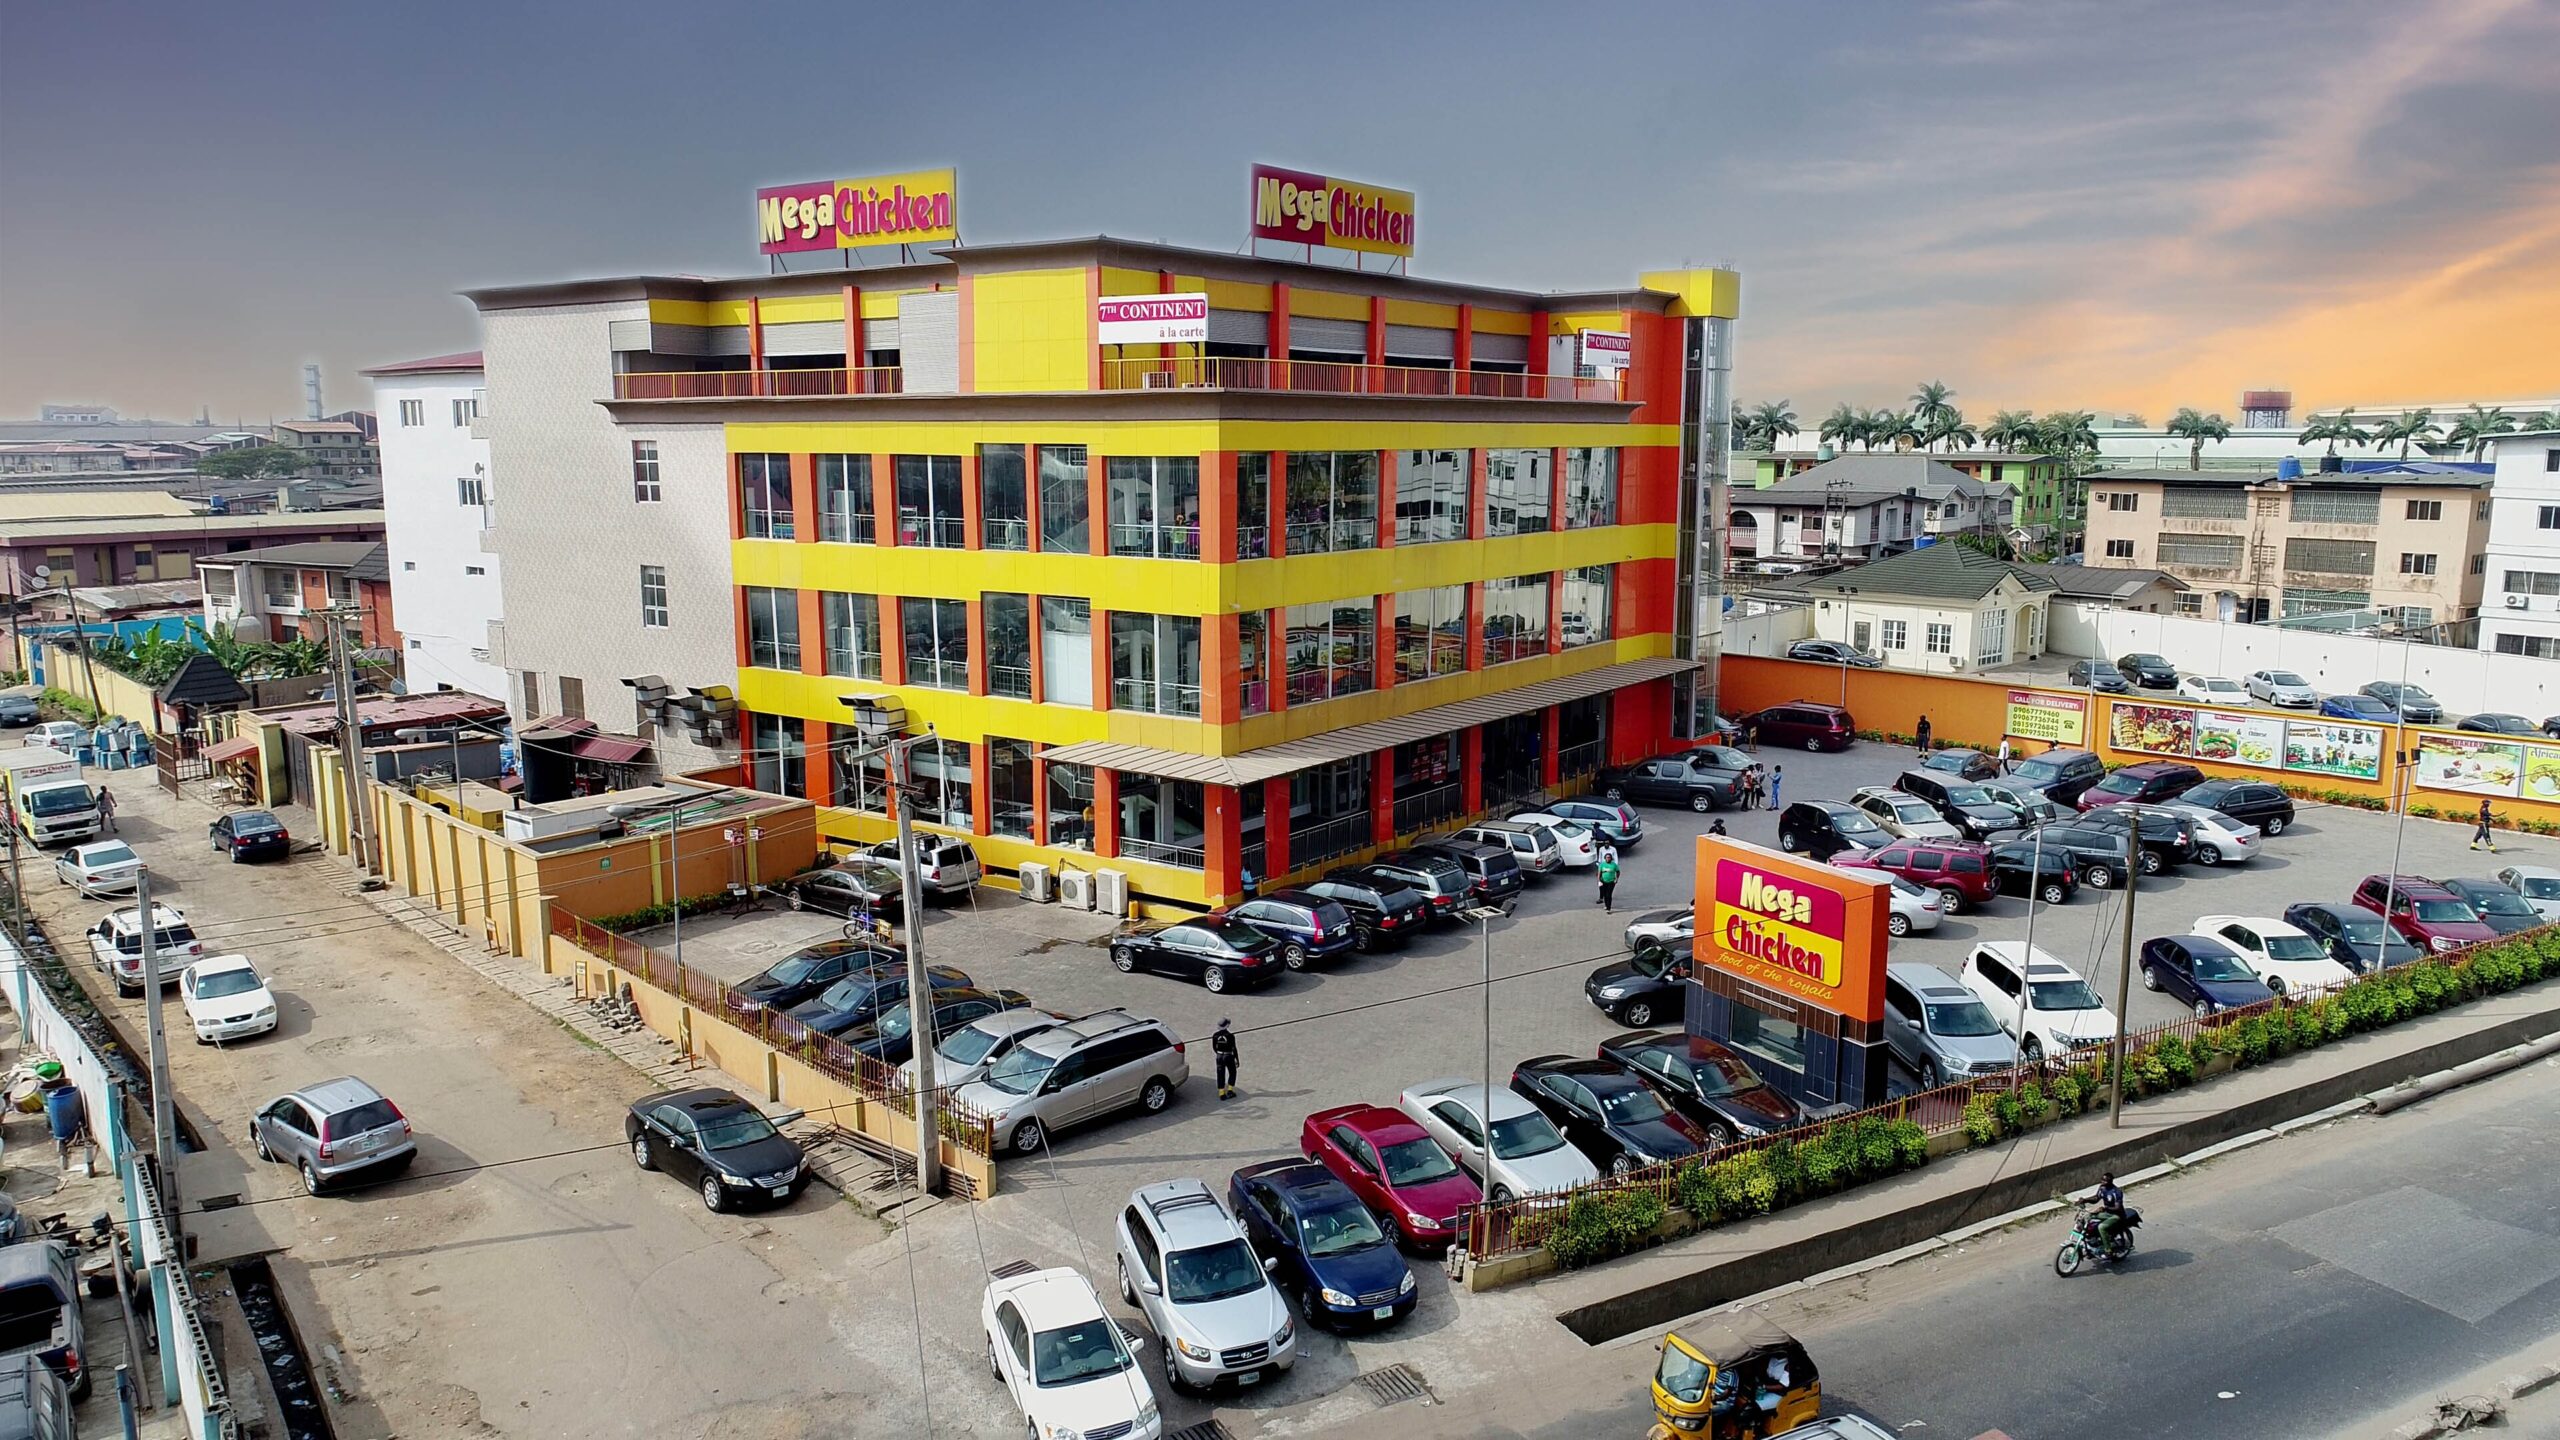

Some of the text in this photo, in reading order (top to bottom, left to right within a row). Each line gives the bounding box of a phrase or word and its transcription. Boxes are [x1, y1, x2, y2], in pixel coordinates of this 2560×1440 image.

[759, 184, 952, 244] Mega Chicken
[1256, 176, 1414, 245] Mega Chicken
[1099, 301, 1205, 320] 7TH CONTINENT
[1167, 327, 1177, 337] la
[1179, 327, 1205, 337] carte
[1596, 337, 1630, 350] CONTINENT
[2015, 696, 2030, 704] CALL
[2031, 698, 2045, 706] FOR
[1740, 871, 1812, 924] Mega
[1726, 913, 1824, 981] Chicken
[1715, 951, 1834, 1000] food of the royals
